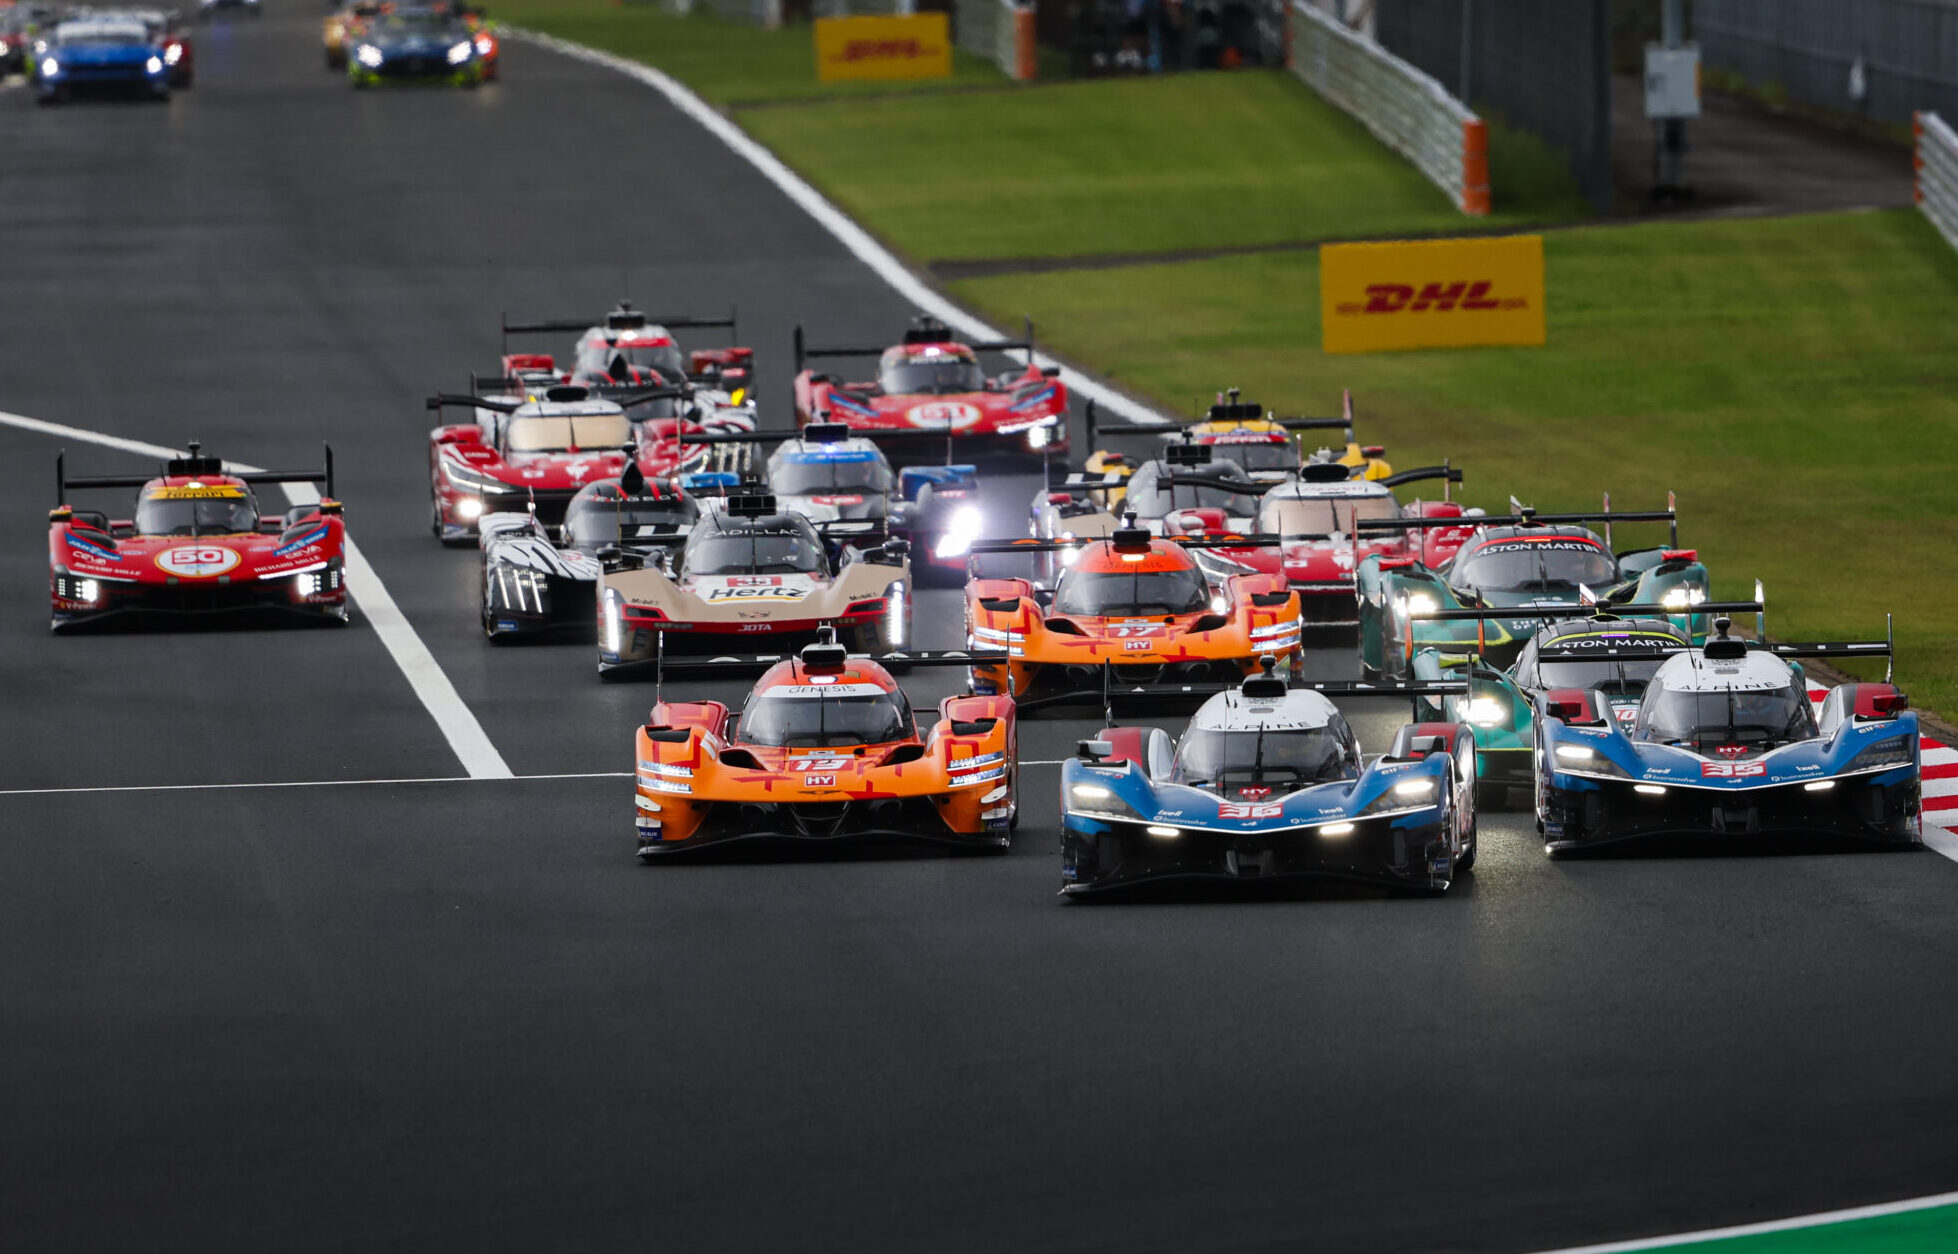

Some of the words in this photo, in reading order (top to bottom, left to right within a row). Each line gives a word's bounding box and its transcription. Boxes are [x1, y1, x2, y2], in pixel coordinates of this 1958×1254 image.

[1364, 280, 1500, 314] DHL
[704, 528, 802, 538] CADILLAC
[1477, 543, 1532, 557] ASTON
[1537, 543, 1600, 554] MARTIN
[173, 551, 222, 564] 50
[709, 587, 808, 600] Hertz
[739, 623, 772, 632] JOTA
[1117, 627, 1159, 637] 17
[1127, 641, 1150, 649] HY
[788, 685, 857, 694] GENESIS
[1678, 681, 1778, 691] ALPINE
[1209, 721, 1312, 730] ALPINE
[1858, 726, 1874, 734] elf
[1719, 745, 1745, 753] HY
[795, 760, 847, 771] 19
[1702, 763, 1765, 777] 35
[807, 776, 833, 785] HY
[1241, 787, 1269, 795] HY
[1219, 803, 1283, 817] 36
